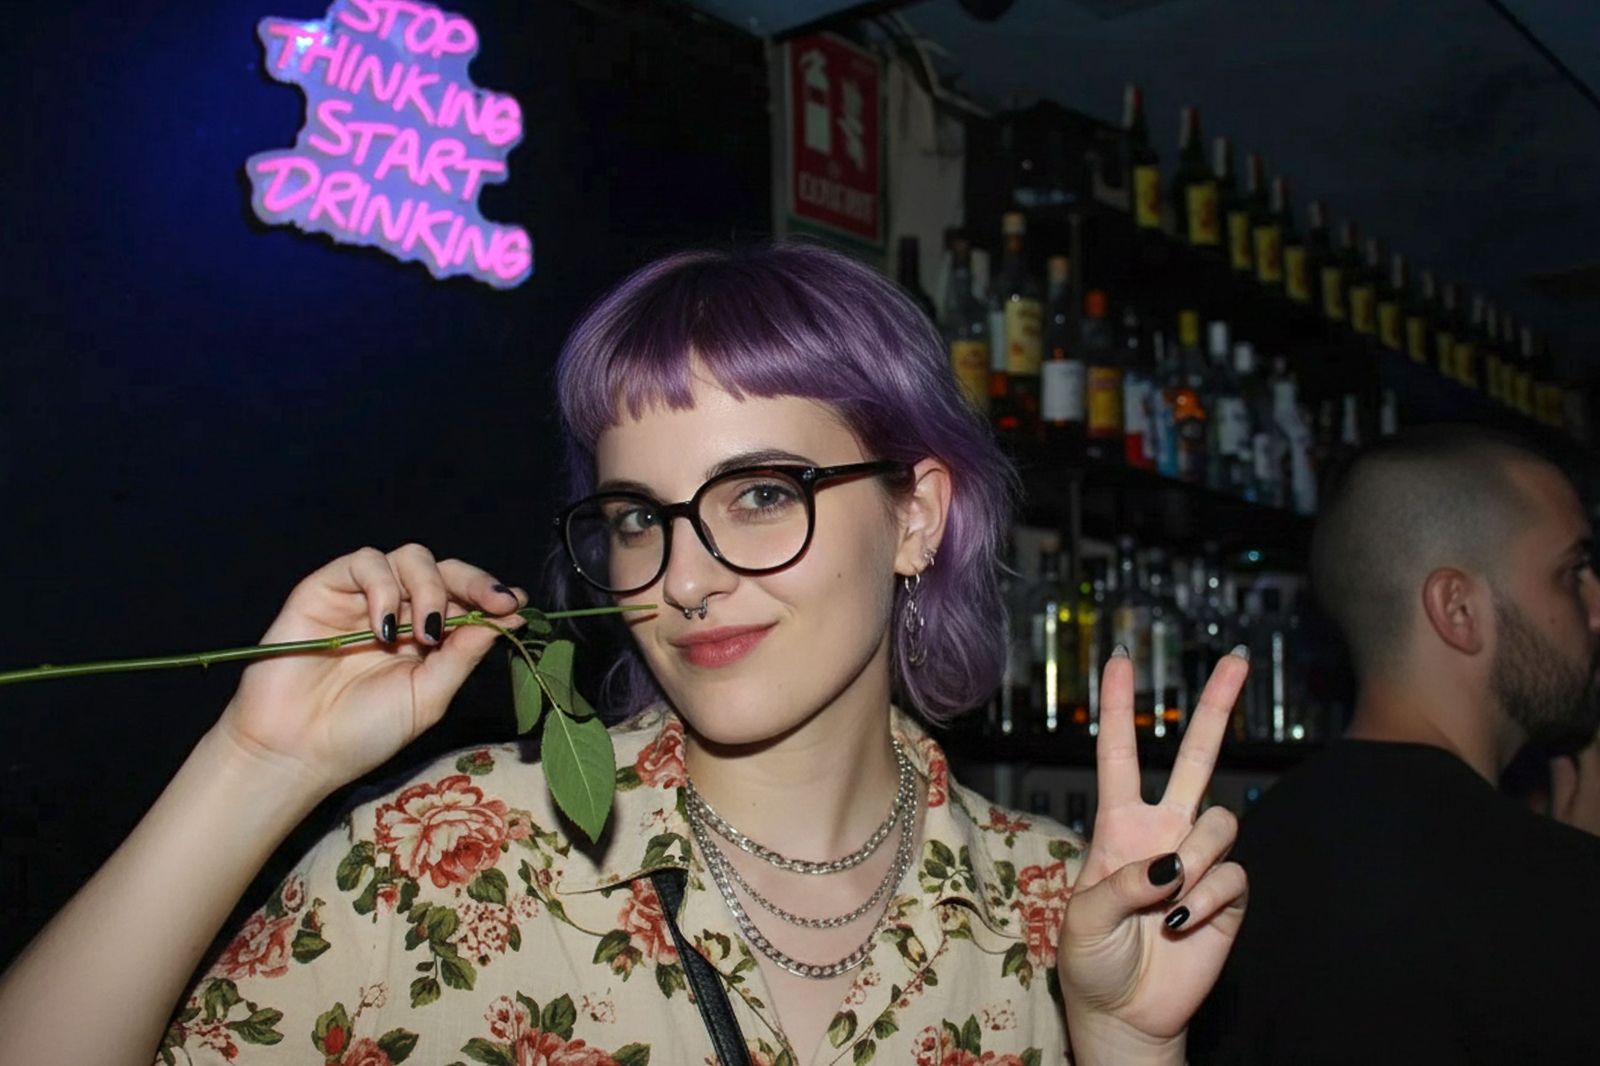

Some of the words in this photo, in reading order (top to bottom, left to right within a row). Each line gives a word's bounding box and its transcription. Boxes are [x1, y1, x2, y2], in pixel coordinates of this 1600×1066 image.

[337, 0, 478, 57] STOP
[268, 23, 521, 146] THINKING
[308, 100, 504, 200] START
[256, 156, 532, 279] DRINKING
